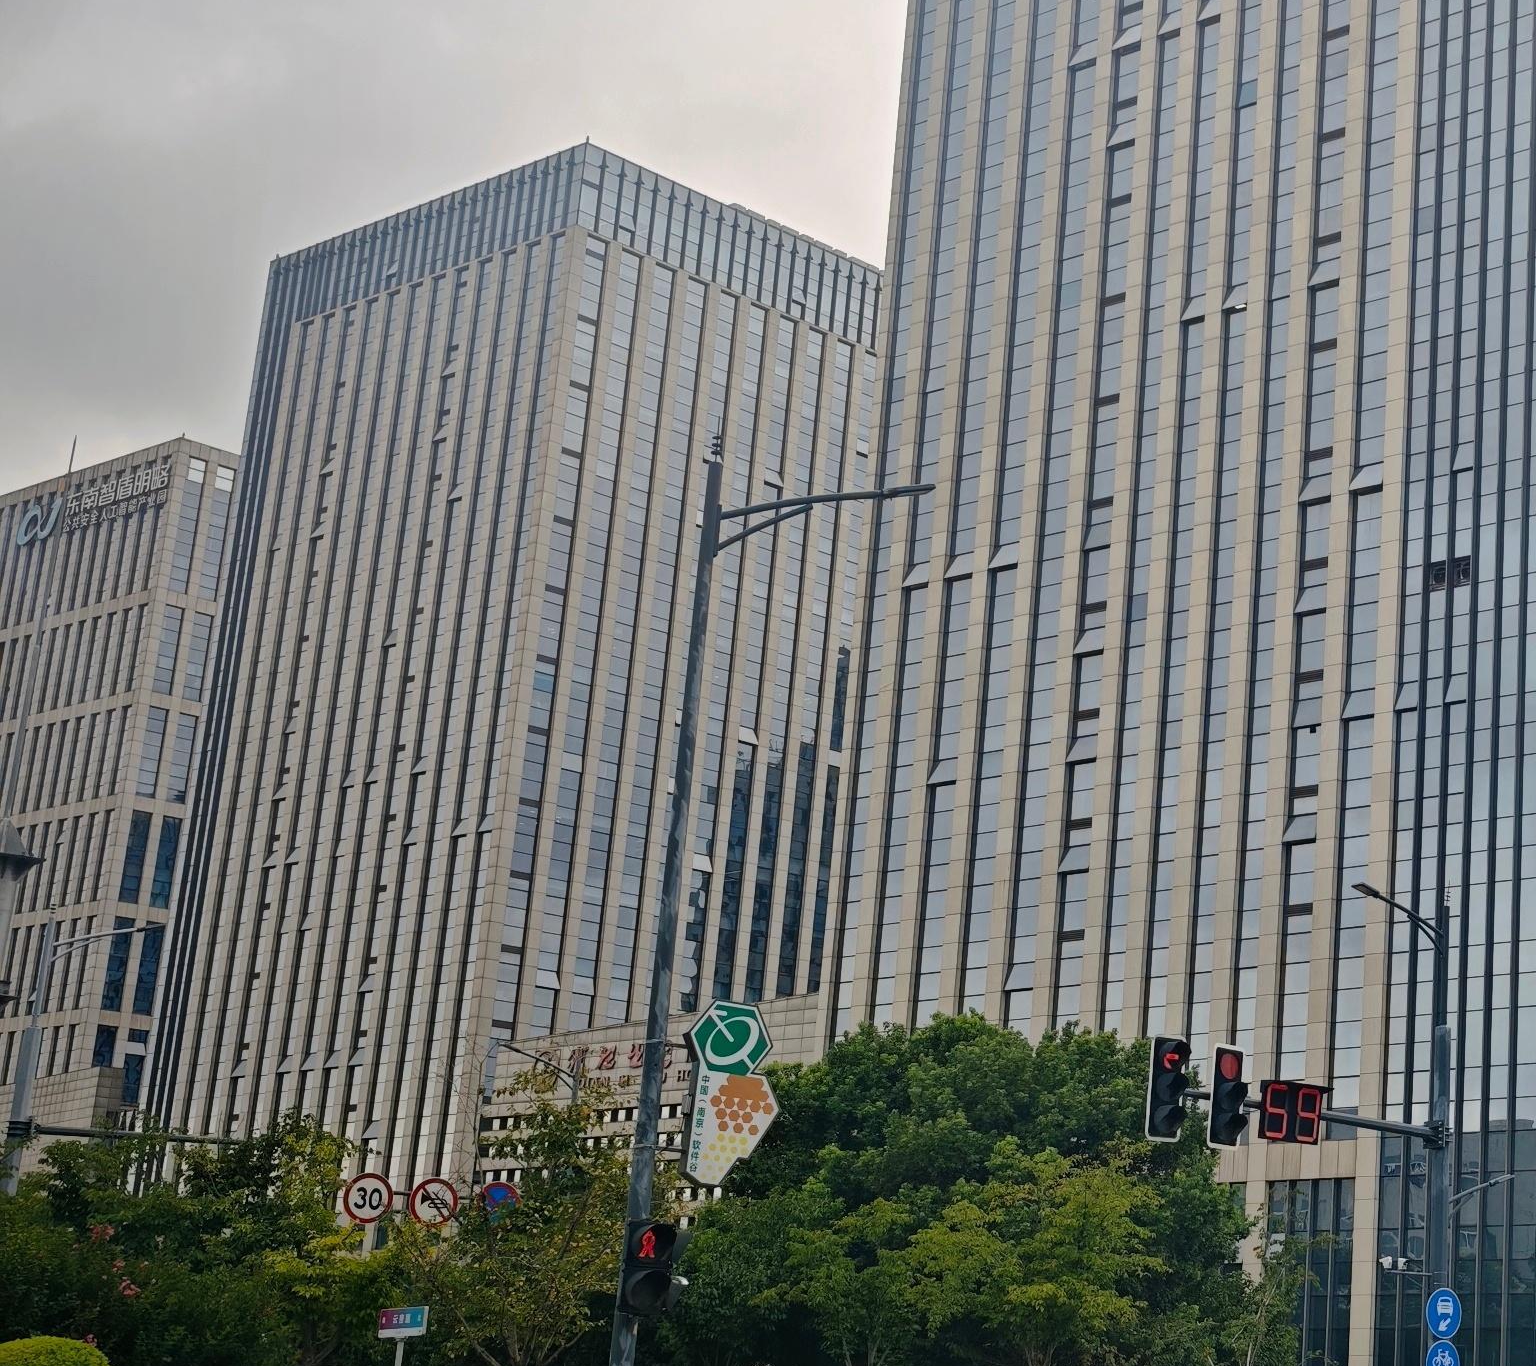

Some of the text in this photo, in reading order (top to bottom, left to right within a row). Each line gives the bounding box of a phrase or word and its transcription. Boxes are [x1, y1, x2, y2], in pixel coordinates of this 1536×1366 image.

[63, 489, 168, 533] 公共安全人工智能产业园
[689, 1075, 711, 1173] 中国（南京）软件谷
[1265, 1083, 1321, 1143] 59
[353, 1186, 383, 1211] 30
